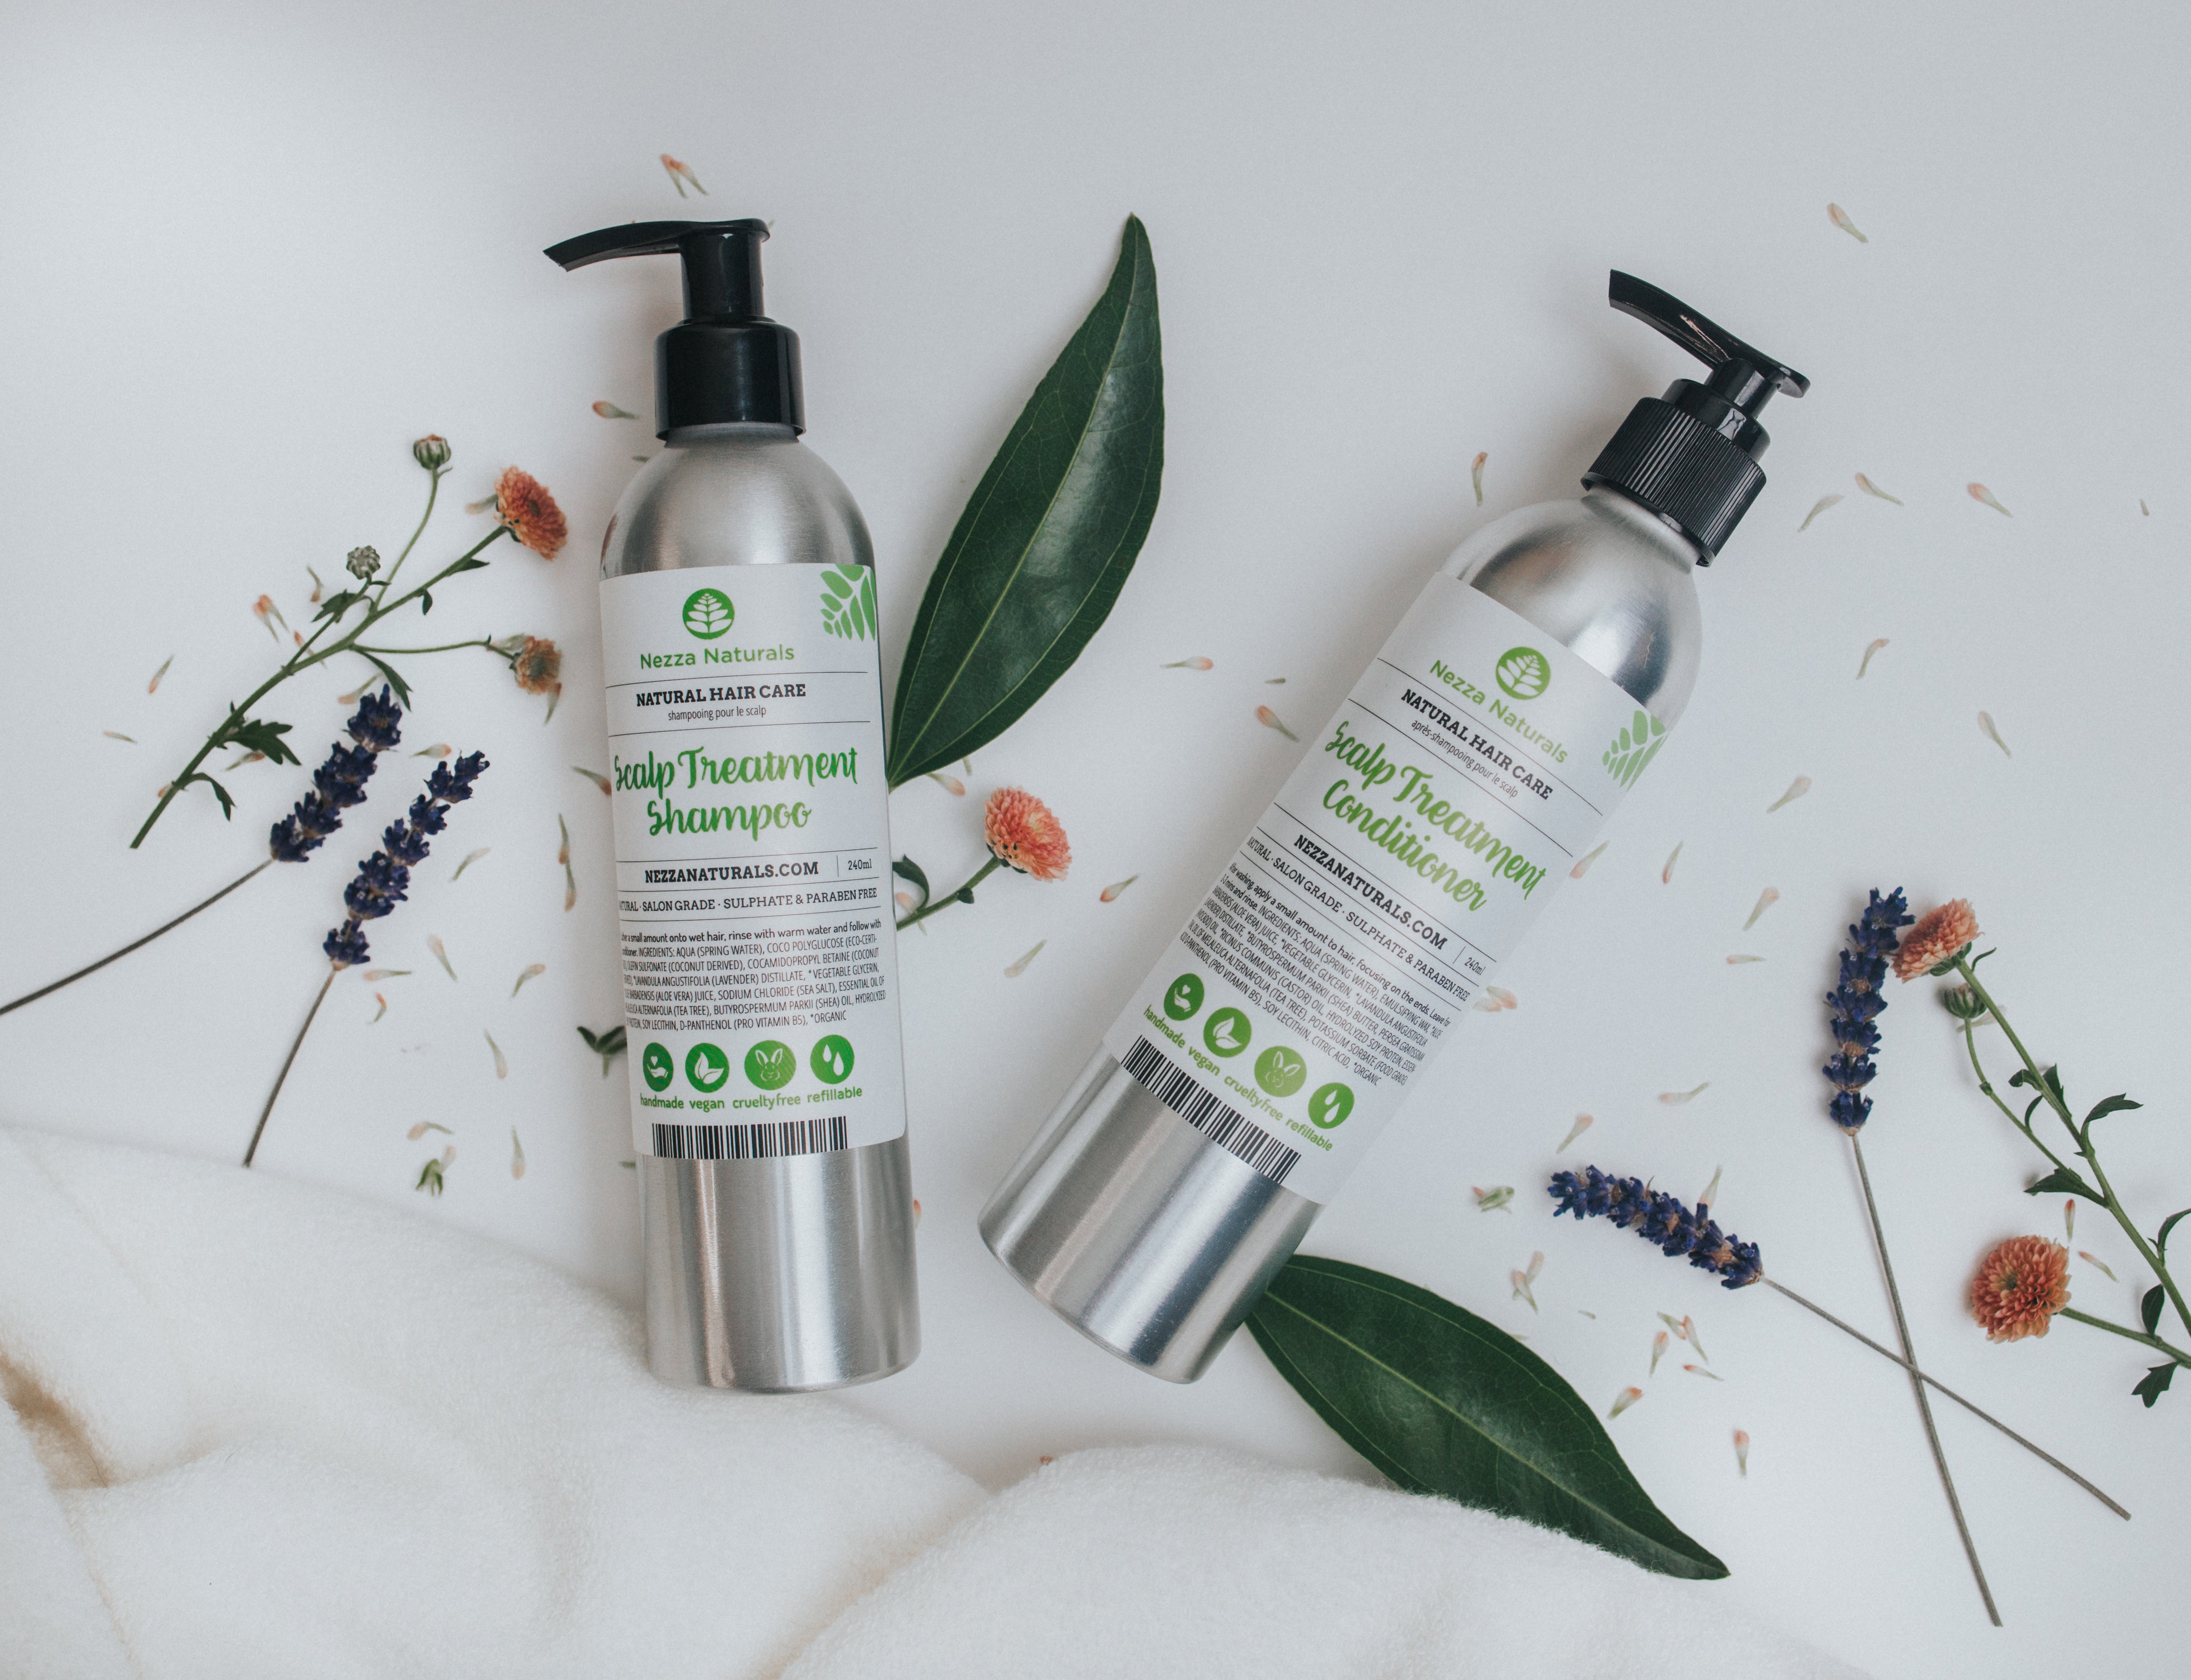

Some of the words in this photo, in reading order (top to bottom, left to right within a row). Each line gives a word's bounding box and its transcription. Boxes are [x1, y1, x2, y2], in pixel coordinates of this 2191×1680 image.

[640, 653, 696, 670] Nezza
[704, 644, 795, 664] Naturals
[636, 689, 706, 707] NATURAL
[709, 686, 756, 701] HAIR
[759, 684, 806, 698] CARE
[668, 709, 714, 722] shampooing
[715, 709, 735, 721] pour
[736, 706, 744, 716] le
[746, 705, 766, 718] scalp
[1429, 660, 1485, 705] Nezza
[1488, 699, 1568, 763] Naturals
[1401, 689, 1468, 741] NATURAL
[1469, 734, 1512, 771] HAIR
[1512, 765, 1553, 800] CARE
[1411, 720, 1475, 769] après-shampooing
[1471, 763, 1493, 778] pour
[1491, 773, 1500, 785] le
[1499, 781, 1518, 799] scalp
[614, 751, 675, 800] Scalp
[677, 746, 858, 789] Treatment
[647, 798, 812, 842] Shampoo
[1324, 721, 1397, 791] Scalp
[1393, 765, 1547, 900] Treatment
[848, 858, 872, 870] 240ml
[1323, 778, 1487, 912] Conditioner
[645, 861, 819, 883] NEZZANATURALS.COM
[1294, 834, 1448, 950] NEZZANATURALS.COM
[642, 901, 673, 912] SALON
[674, 899, 715, 911] GRADE
[723, 895, 793, 909] SULPHATE
[795, 894, 804, 904] &
[806, 889, 856, 904] PARABEN
[858, 888, 877, 899] FREE
[1247, 836, 1272, 861] NATURAL
[1273, 858, 1306, 885] SALON
[1304, 881, 1342, 913] GRADE
[1346, 912, 1407, 959] SULPHATE
[1405, 953, 1414, 965] &
[1413, 959, 1456, 992] PARABEN
[1452, 986, 1471, 1002] FREE
[631, 932, 643, 942] small
[643, 933, 668, 943] amount
[669, 933, 687, 942] onto
[688, 932, 705, 942] wet
[728, 931, 752, 940] rinse
[754, 928, 775, 939] with
[777, 929, 805, 937] warm
[806, 925, 832, 935] water
[833, 922, 847, 933] and
[849, 920, 869, 931] follow
[676, 947, 696, 959] AQUA
[767, 942, 790, 953] COCO
[1253, 885, 1272, 902] apply
[1275, 902, 1298, 920] small
[1295, 917, 1328, 943] amount
[1328, 938, 1337, 950] to
[1356, 959, 1391, 990] focusing
[1390, 985, 1401, 996] on
[1401, 990, 1414, 1004] the
[1429, 1009, 1445, 1024] Leave
[823, 951, 850, 964] BETAINE
[1233, 888, 1246, 899] and
[1299, 938, 1322, 958] AQUA
[1379, 994, 1421, 1025] EMULSIFYING
[1464, 957, 1486, 975] 240ml
[718, 989, 752, 1000] SODIUM
[754, 986, 794, 999] CHLORIDE
[839, 978, 870, 991] ESSENTIAL
[789, 999, 813, 1010] PARKII
[855, 990, 886, 1004] HYDROLYZED
[1183, 935, 1211, 964] D-PANTHENOL
[1223, 969, 1251, 995] VITAMIN
[1262, 1001, 1280, 1016] SOY
[1312, 1036, 1336, 1056] CITRIC
[1200, 932, 1229, 960] MELALEUCA
[1308, 1015, 1350, 1048] POTASSIUM
[1348, 1043, 1378, 1067] SORBATE
[1241, 947, 1280, 980] COMMUNIS
[1326, 1010, 1369, 1043] HYDROLYZED
[1367, 1038, 1383, 1052] SOY
[1305, 977, 1330, 999] PARKII
[1378, 1028, 1401, 1048] PERSEA
[642, 1019, 651, 1029] SOY
[680, 1020, 732, 1030] D-PANTHENOL
[755, 1016, 790, 1028] VITAMIN
[640, 1093, 684, 1109] handmade
[689, 1099, 725, 1113] vegan
[807, 1086, 862, 1103] refillable
[1143, 1004, 1186, 1048] handmade
[1188, 1046, 1220, 1076] vegan
[1285, 1118, 1333, 1151] refillable
